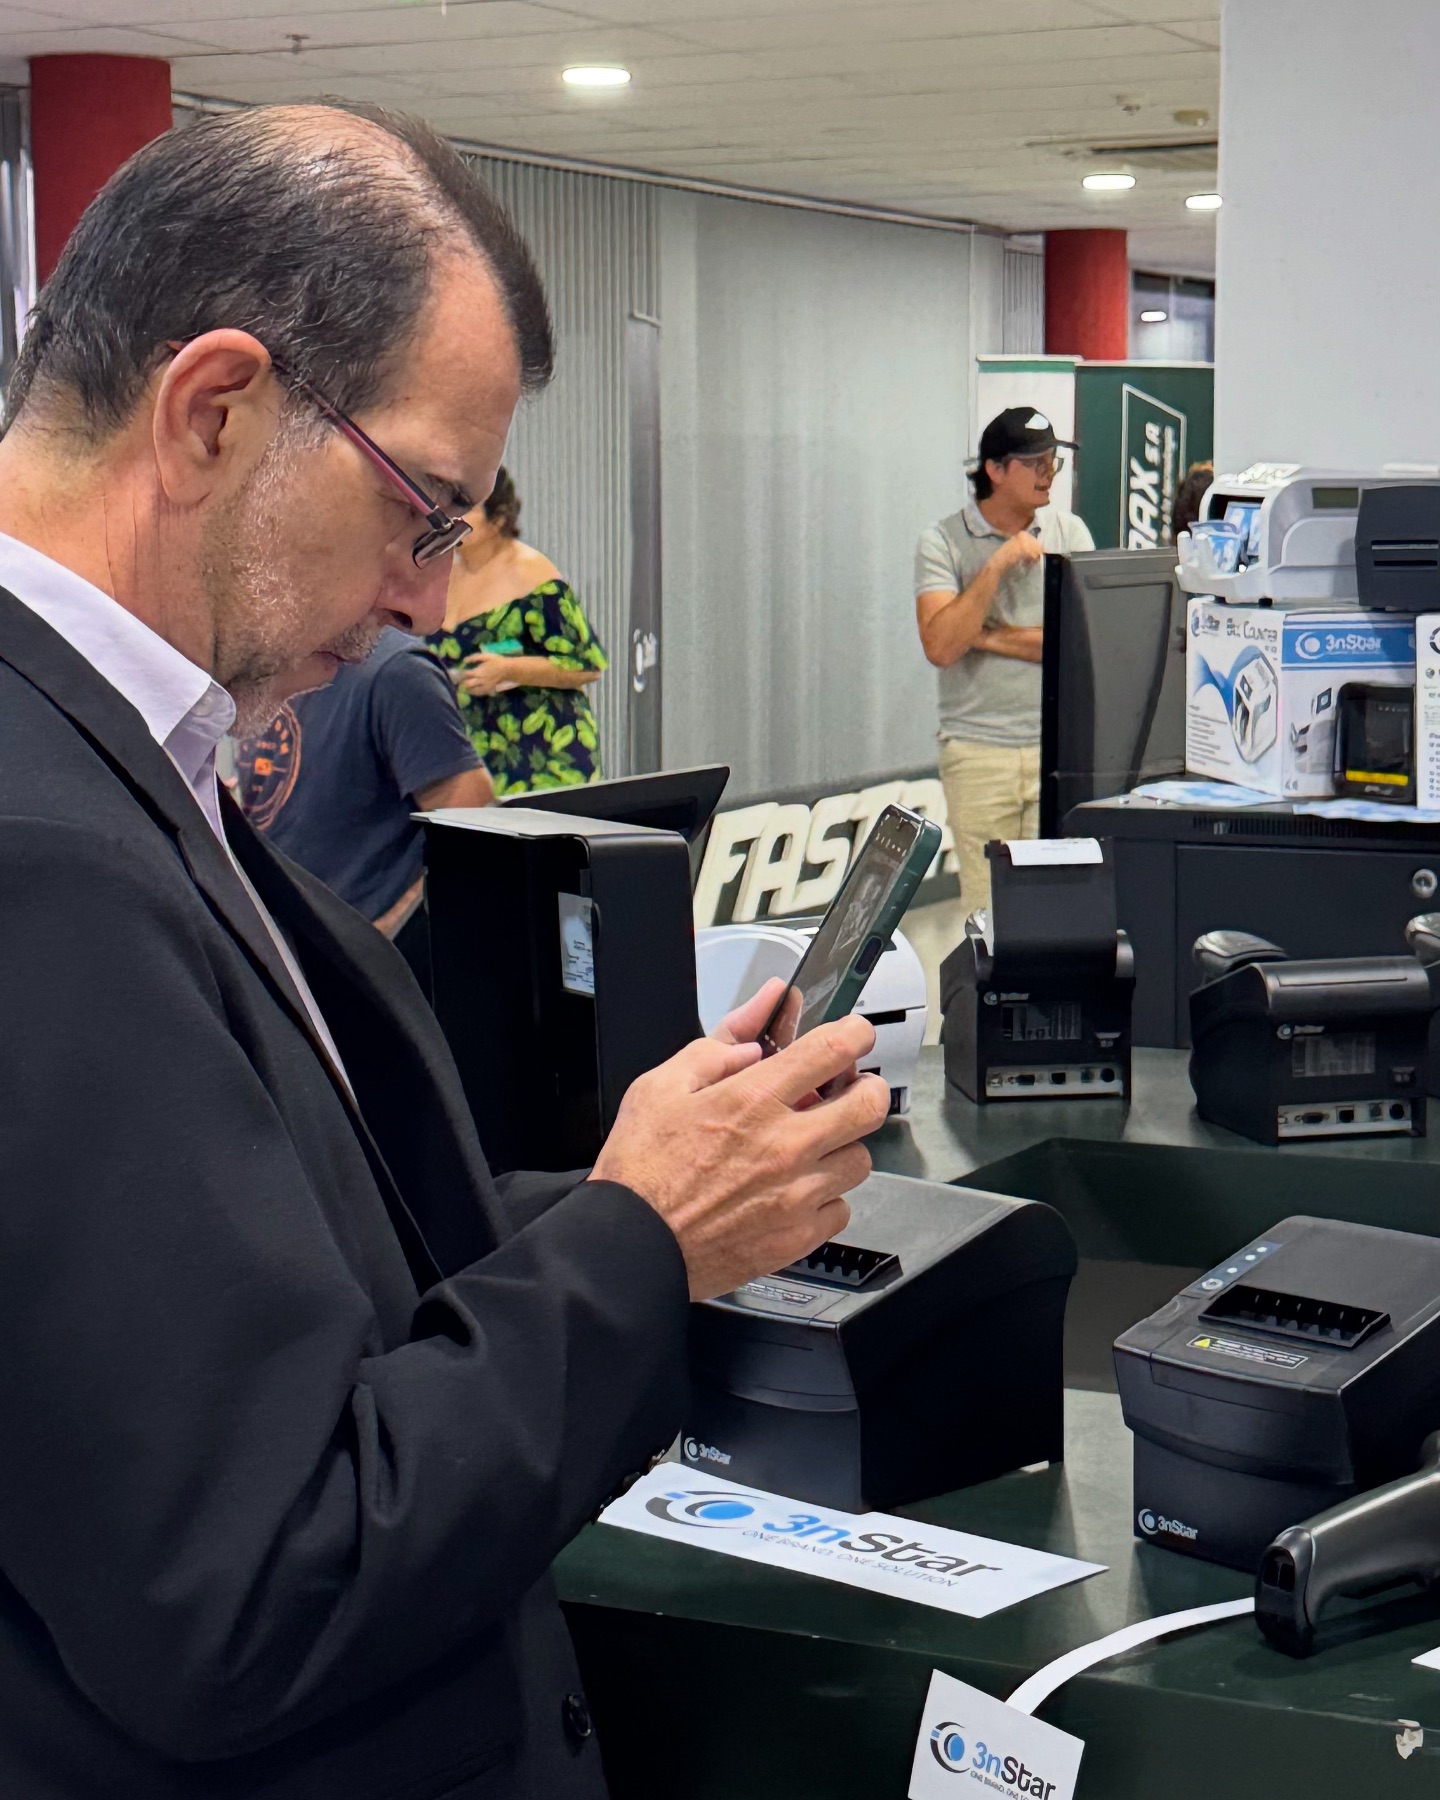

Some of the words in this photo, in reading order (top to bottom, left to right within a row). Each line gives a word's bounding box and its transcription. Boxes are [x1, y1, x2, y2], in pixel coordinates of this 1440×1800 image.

[1325, 633, 1383, 651] 3nStar
[763, 1514, 1003, 1577] 3nStar
[1157, 1515, 1198, 1540] 3nStar
[972, 1741, 1057, 1800] 3nStar
